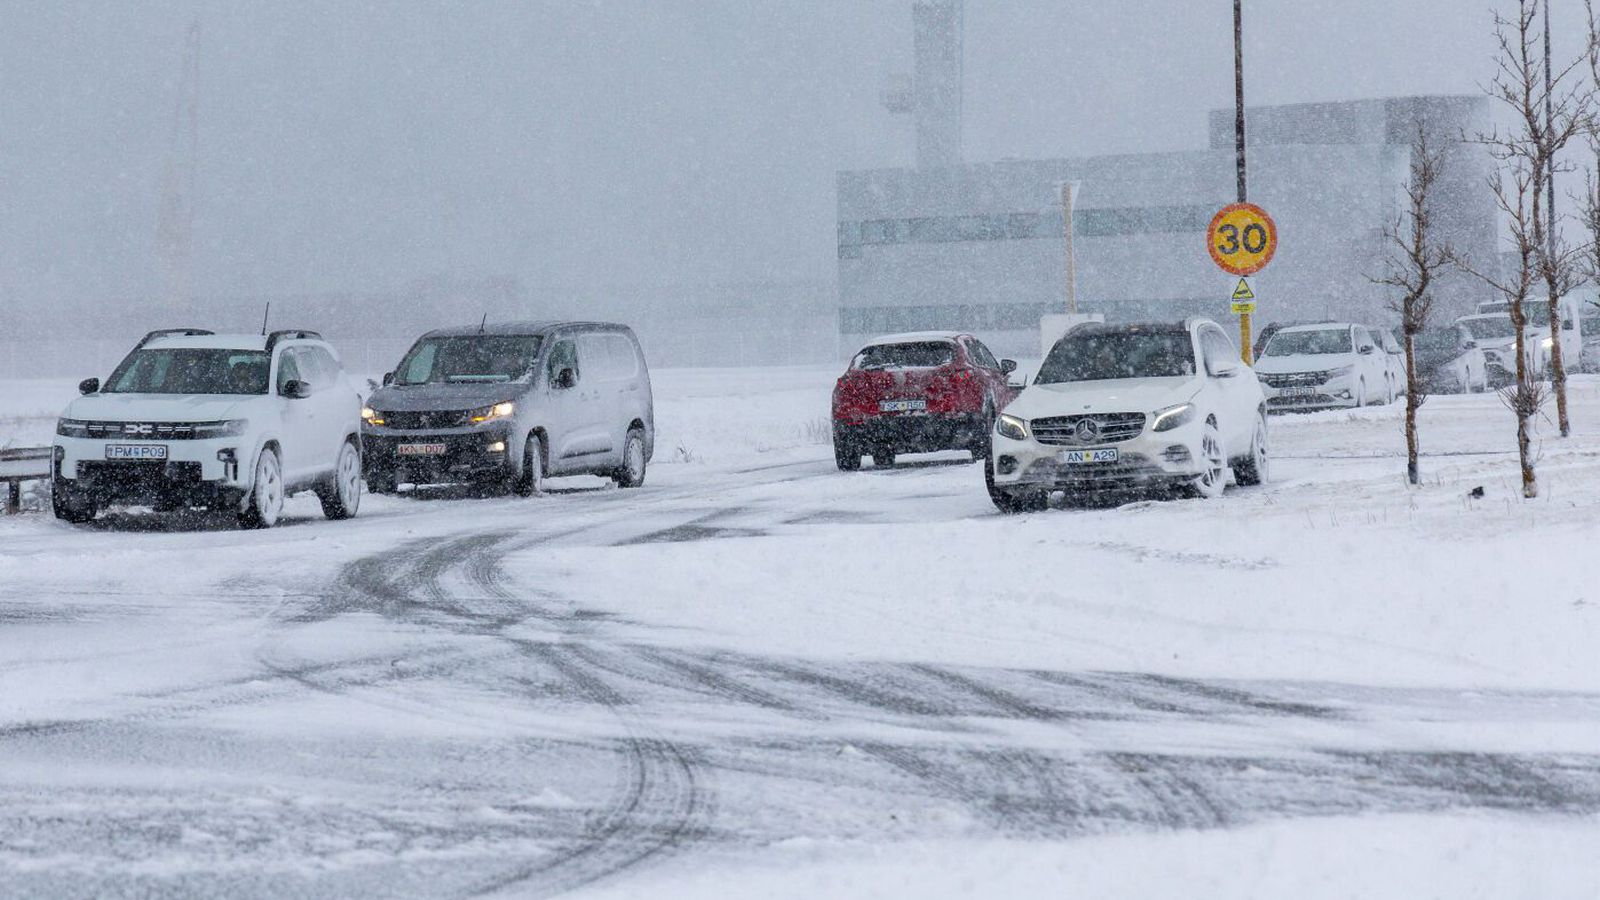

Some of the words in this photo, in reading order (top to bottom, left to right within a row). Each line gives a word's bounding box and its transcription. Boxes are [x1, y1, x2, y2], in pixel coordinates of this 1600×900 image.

[1218, 223, 1267, 255] 30
[114, 447, 131, 457] PM
[141, 447, 165, 457] P09
[1067, 452, 1083, 462] AN
[1093, 450, 1116, 461] A29
